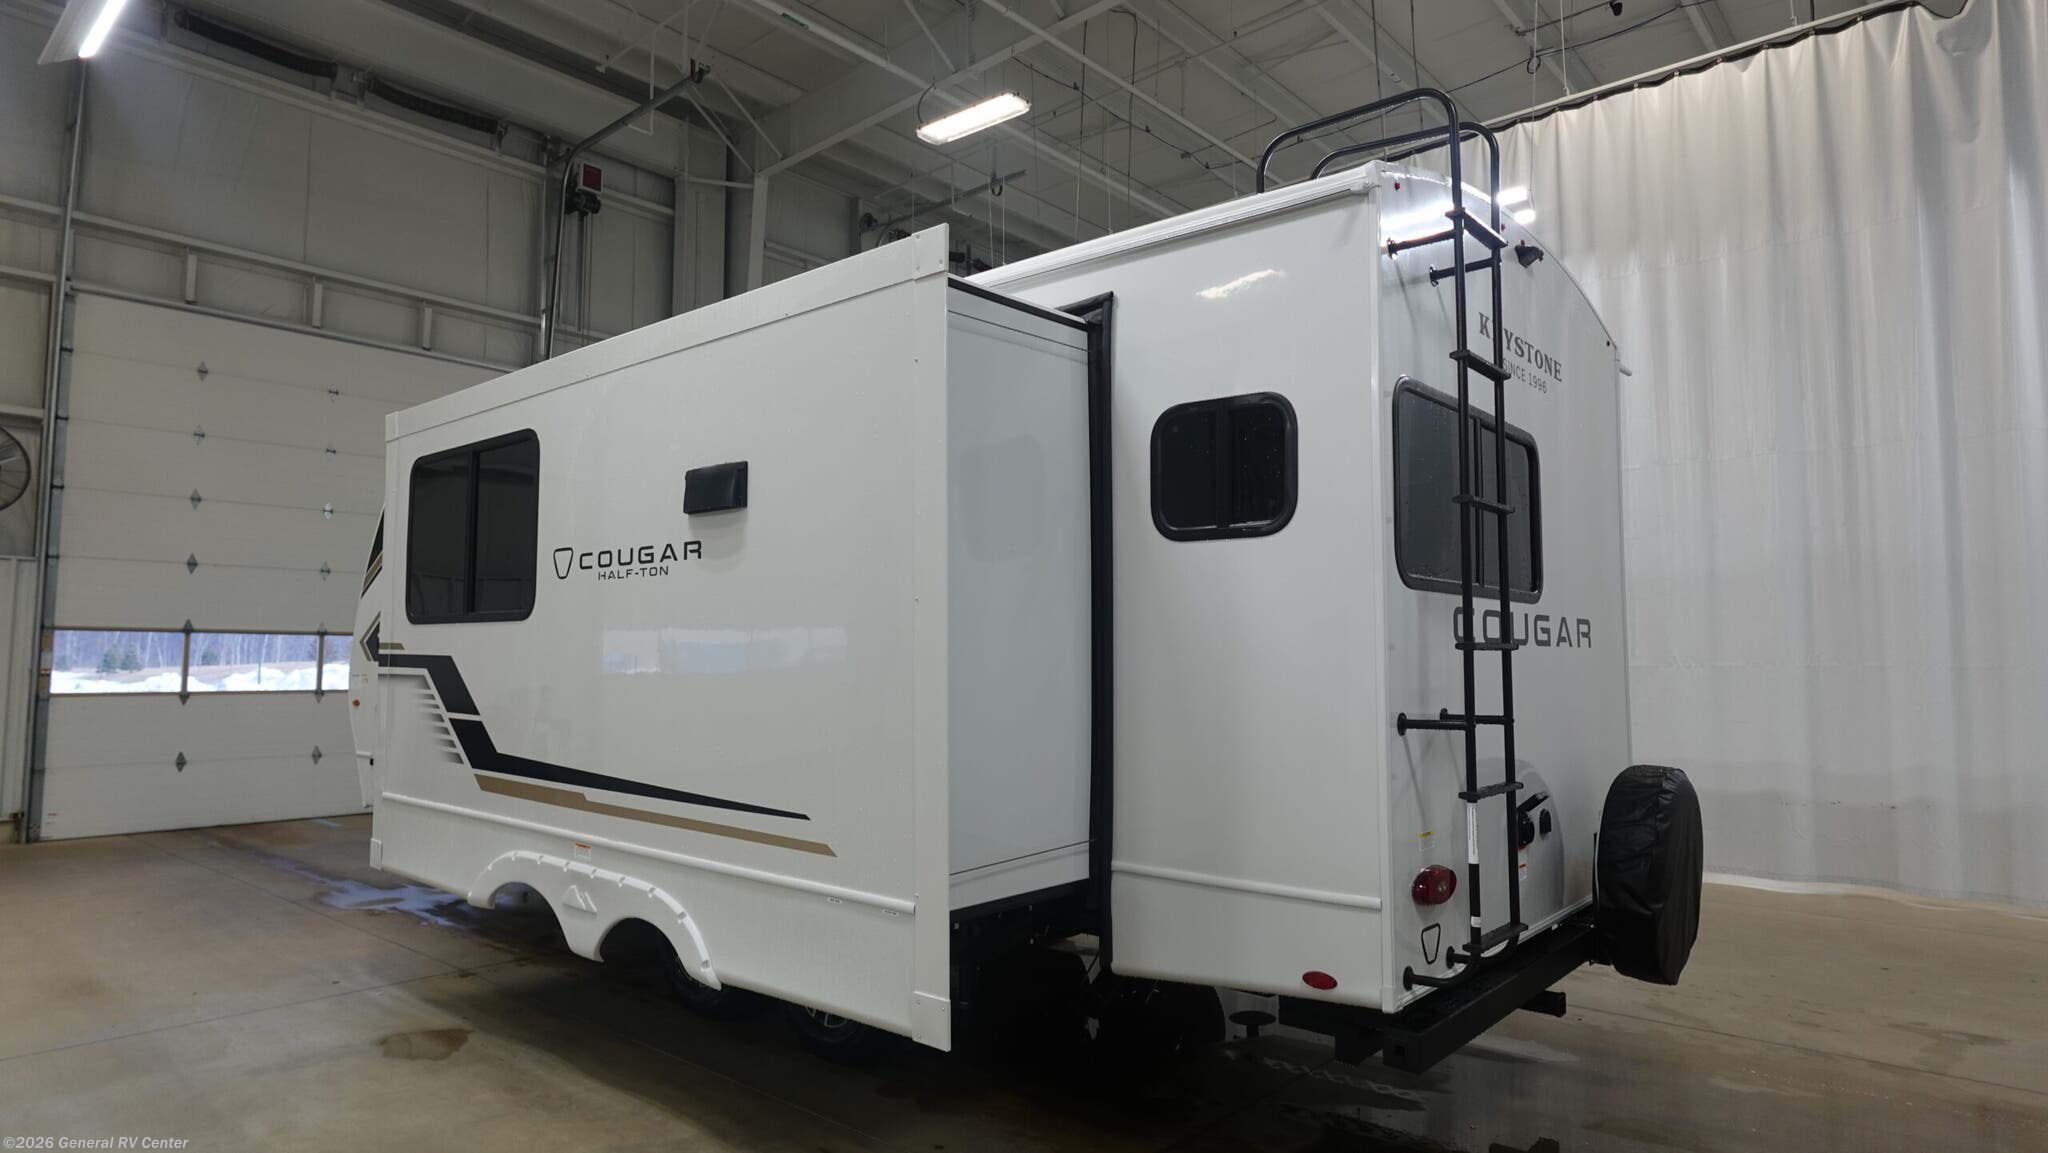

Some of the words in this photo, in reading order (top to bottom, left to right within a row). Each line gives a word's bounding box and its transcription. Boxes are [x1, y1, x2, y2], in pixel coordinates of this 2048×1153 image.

[1479, 312, 1562, 382] KYSTONE
[1503, 358, 1526, 382] SINCE
[1528, 372, 1547, 395] 1996
[579, 540, 702, 570] COUGAR
[598, 566, 669, 581] HALF-TON
